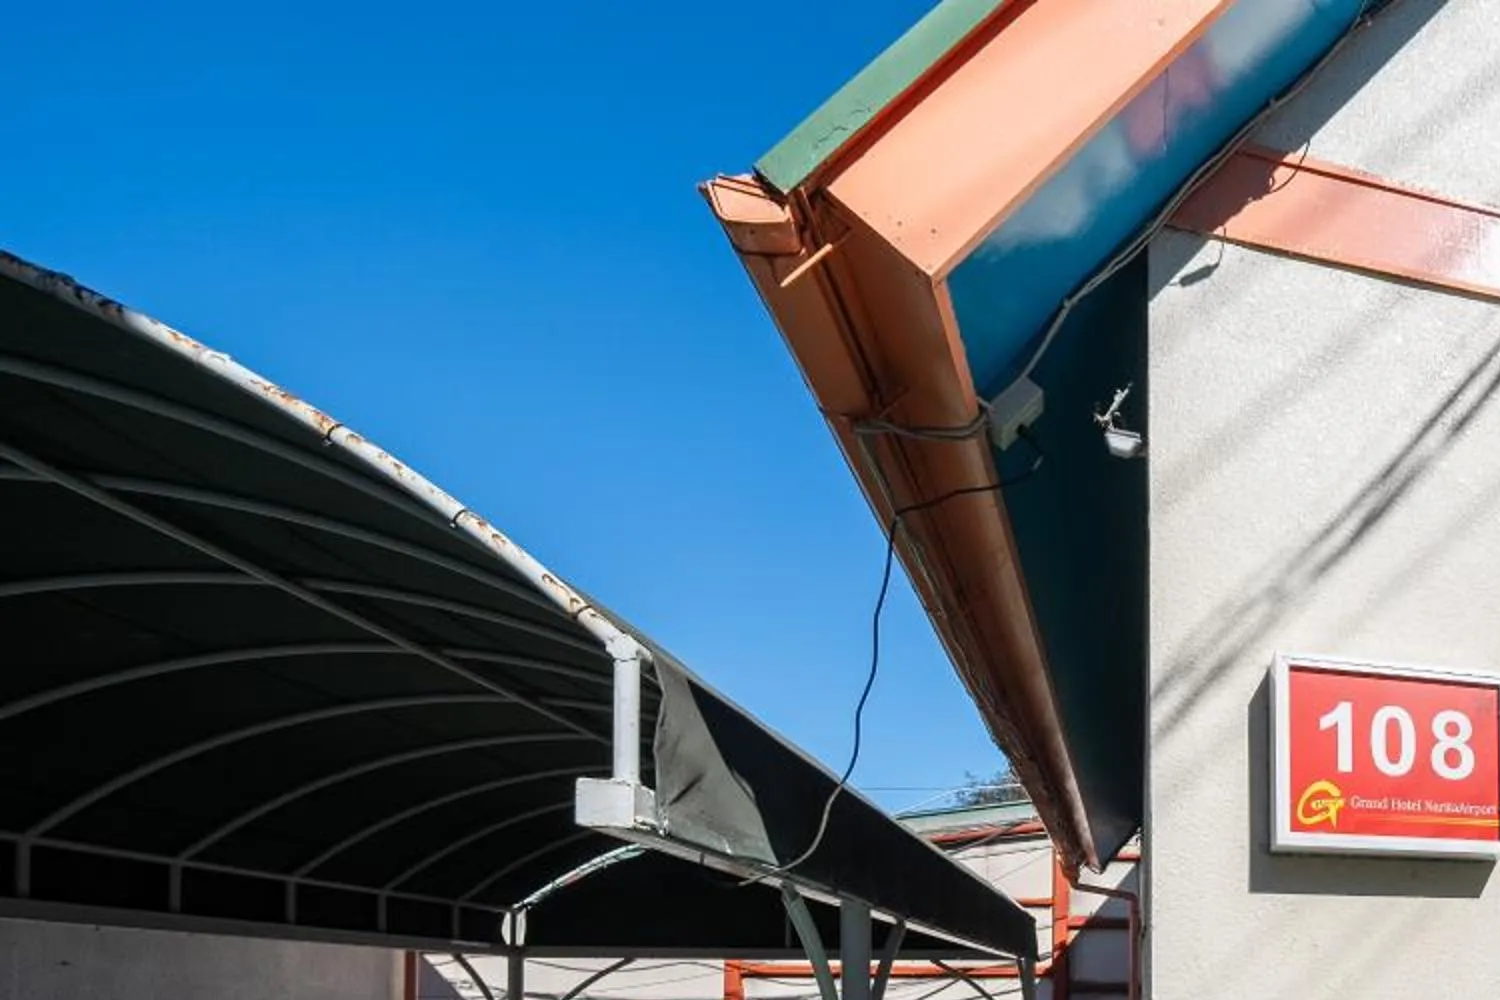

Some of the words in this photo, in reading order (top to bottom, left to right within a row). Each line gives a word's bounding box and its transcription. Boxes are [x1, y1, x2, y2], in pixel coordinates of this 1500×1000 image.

[1319, 700, 1475, 780] 108
[1350, 795, 1389, 810] Grand
[1391, 798, 1421, 812] Hotel
